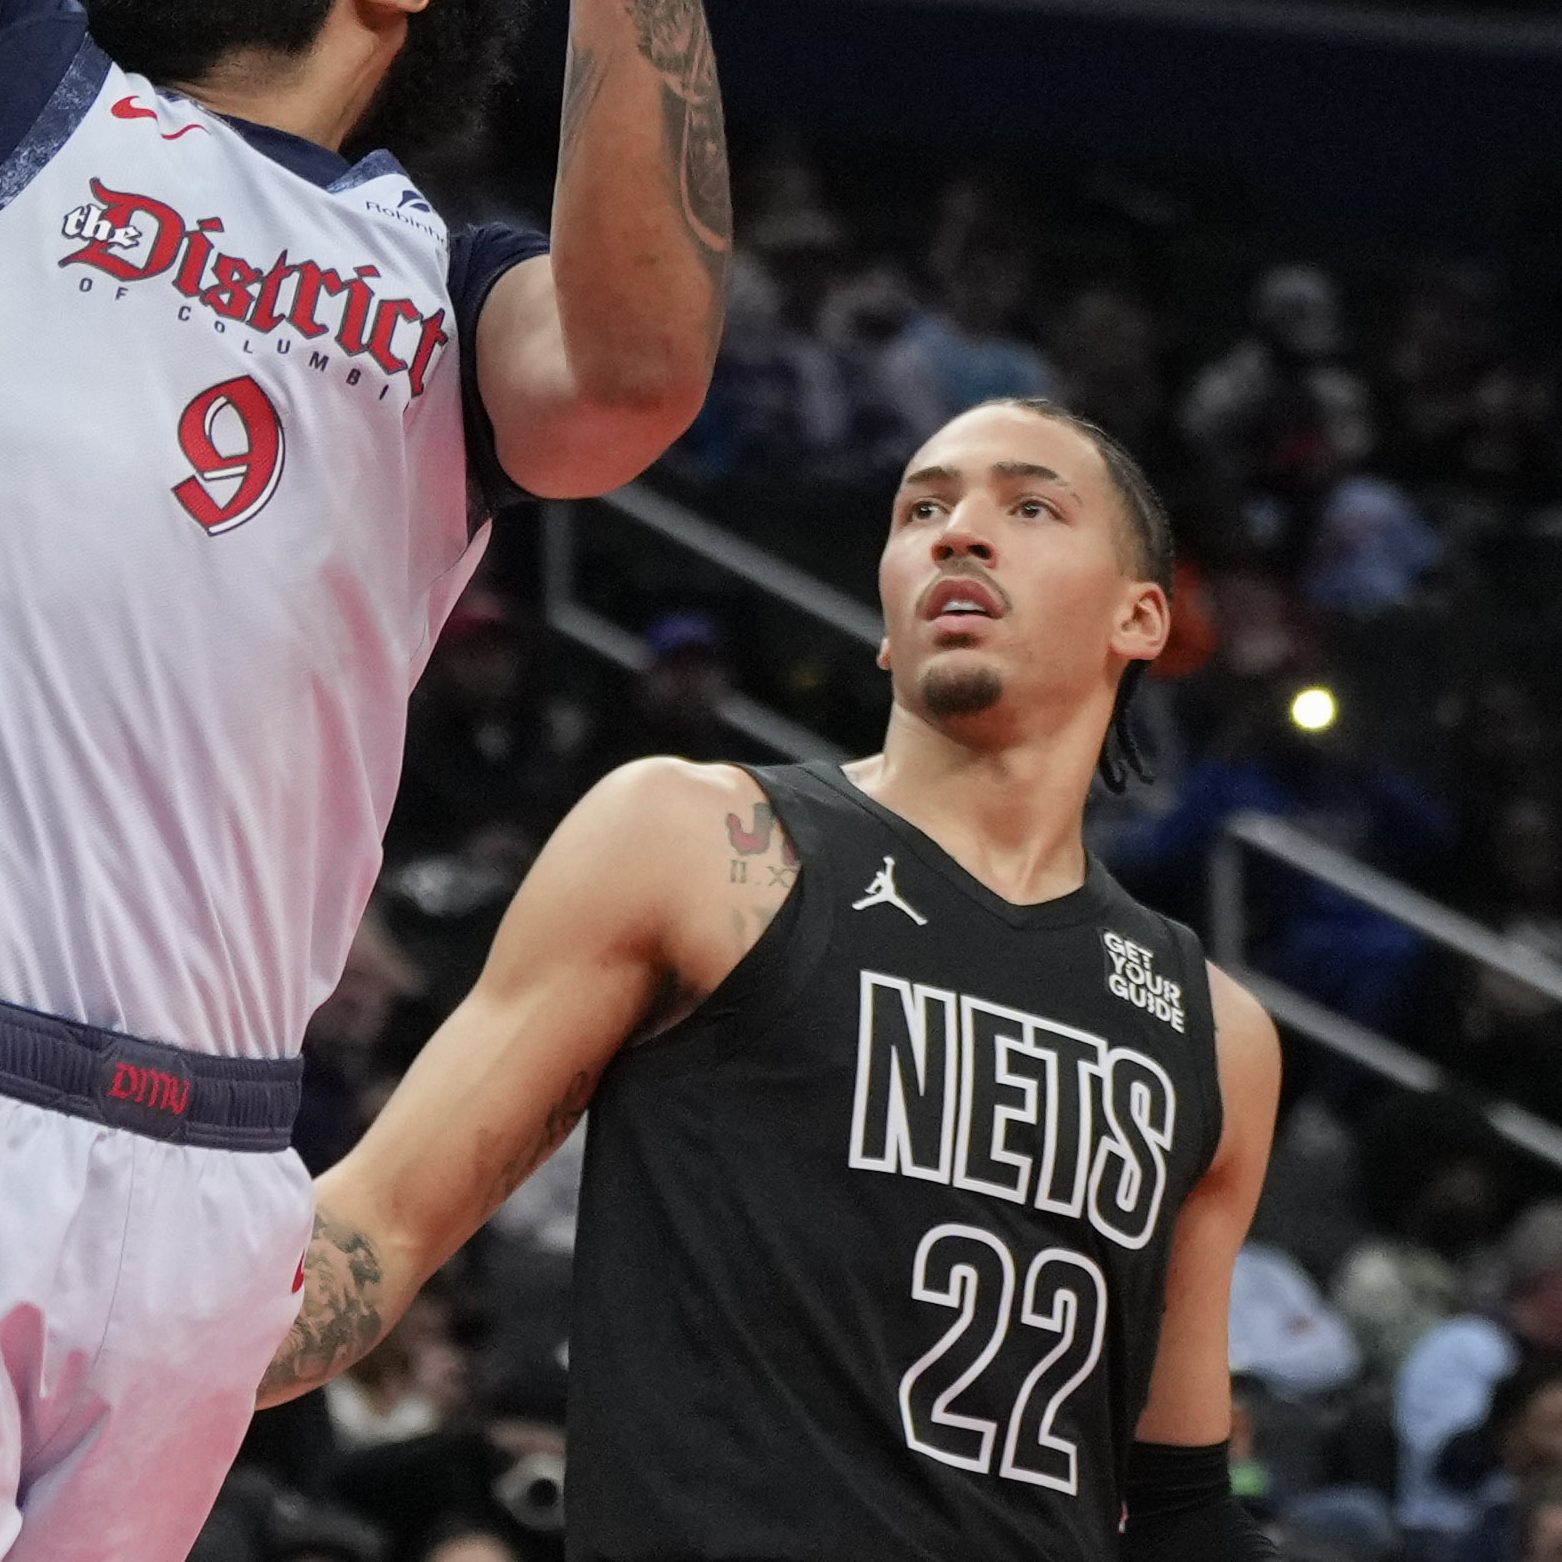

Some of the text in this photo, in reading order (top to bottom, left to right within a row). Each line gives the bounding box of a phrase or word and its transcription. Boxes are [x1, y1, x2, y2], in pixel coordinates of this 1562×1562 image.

[58, 176, 449, 399] the District
[78, 276, 130, 302] OF
[170, 374, 287, 537] 9
[1102, 929, 1154, 968] GET
[1107, 952, 1184, 1008] YOUR
[1107, 972, 1186, 1035] GUIDE
[847, 969, 1176, 1251] NETS
[898, 1223, 1108, 1497] 22
